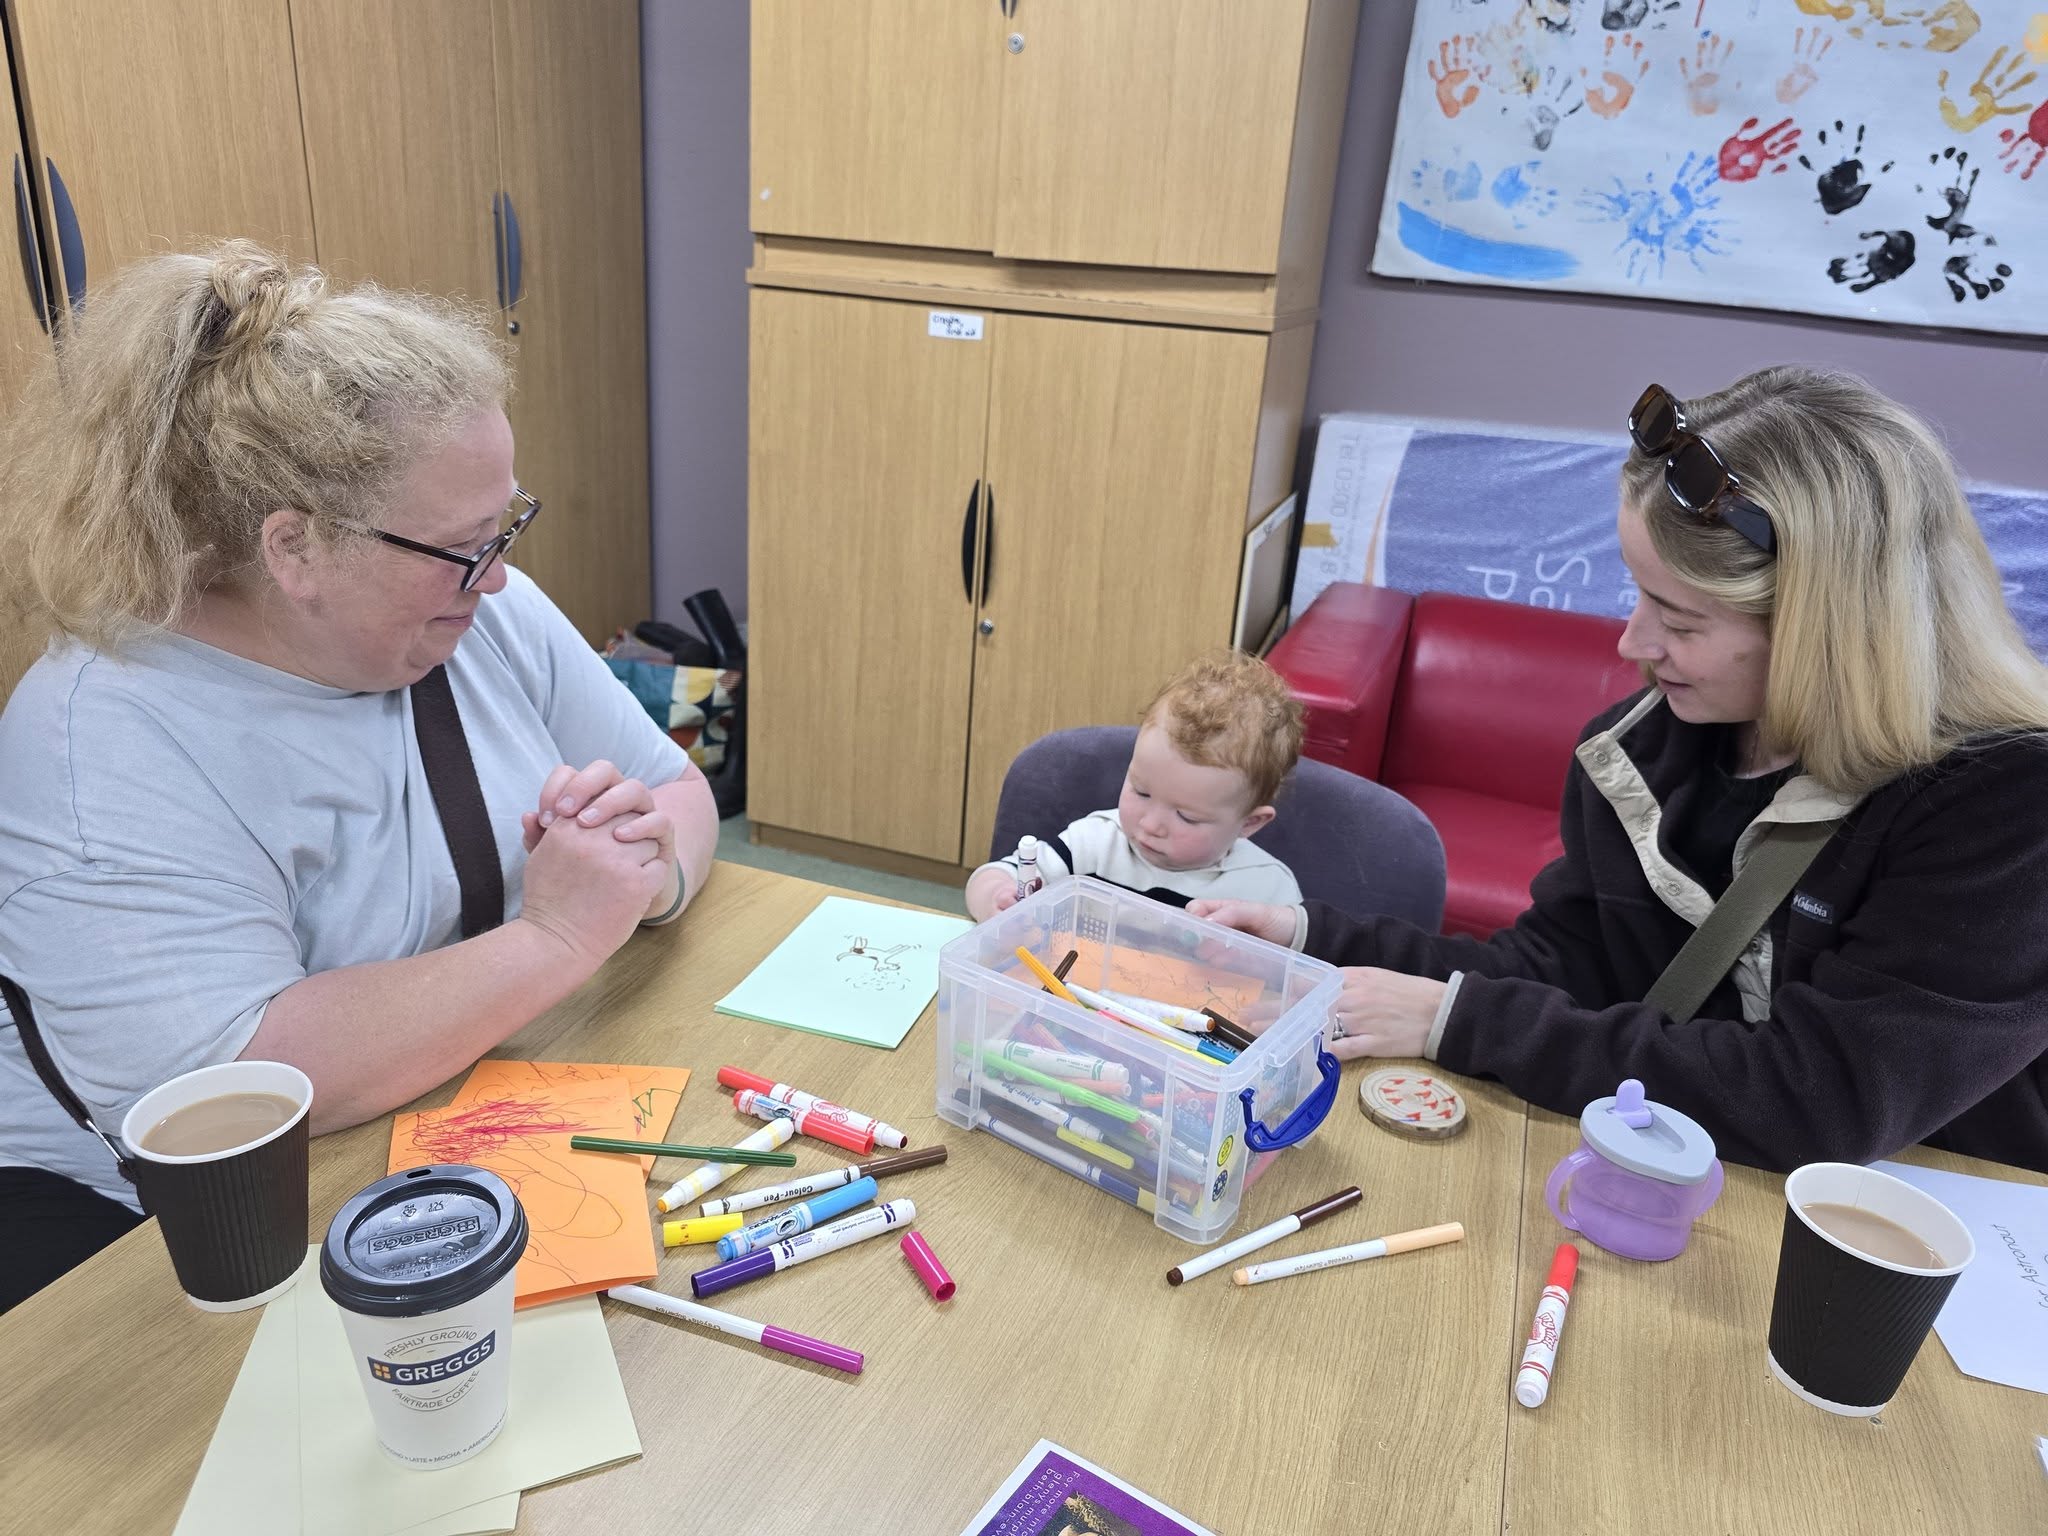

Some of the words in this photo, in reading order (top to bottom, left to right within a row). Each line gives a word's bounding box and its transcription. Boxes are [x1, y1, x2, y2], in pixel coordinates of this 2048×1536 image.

[1797, 895, 1827, 918] Columbia
[763, 1184, 814, 1204] Colour-Pen
[373, 1223, 458, 1254] GREGGS
[384, 1336, 425, 1359] FRESHLY
[429, 1330, 478, 1342] GROUND
[395, 1339, 491, 1382] GREGGS
[391, 1388, 443, 1409] FAIRTRADE
[445, 1370, 480, 1403] COFFEE
[1064, 1471, 1080, 1488] For
[1040, 1489, 1063, 1515] more
